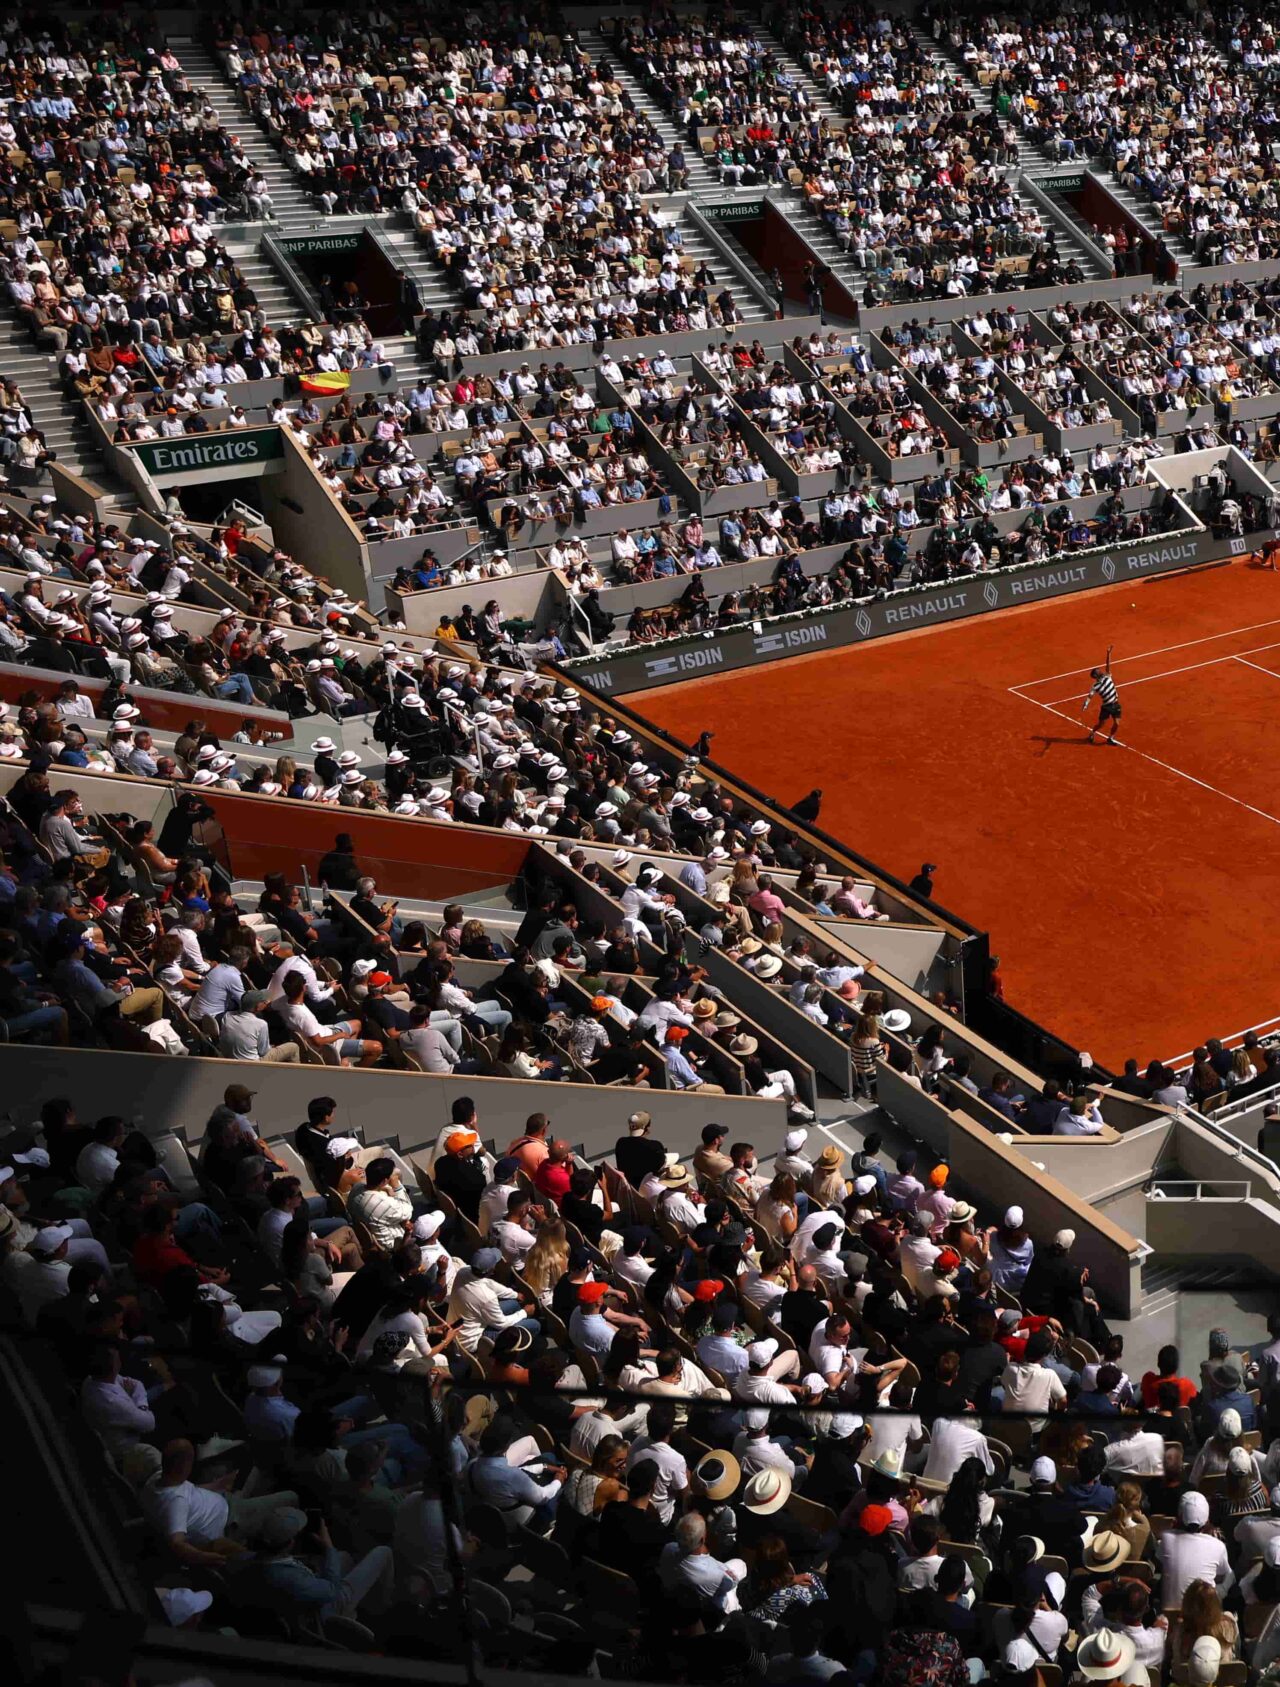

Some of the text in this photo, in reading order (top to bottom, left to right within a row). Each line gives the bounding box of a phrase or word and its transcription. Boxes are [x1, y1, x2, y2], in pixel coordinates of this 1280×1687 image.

[1049, 178, 1081, 188] PARIBAS
[720, 205, 760, 216] PARIBAS
[308, 239, 358, 251] PARIBAS
[152, 440, 259, 469] Emirates
[1233, 541, 1245, 552] 10
[885, 542, 1198, 624] RENAULT RENAULT RENAULT
[582, 624, 827, 690] DIN ISDIN ISDIN
